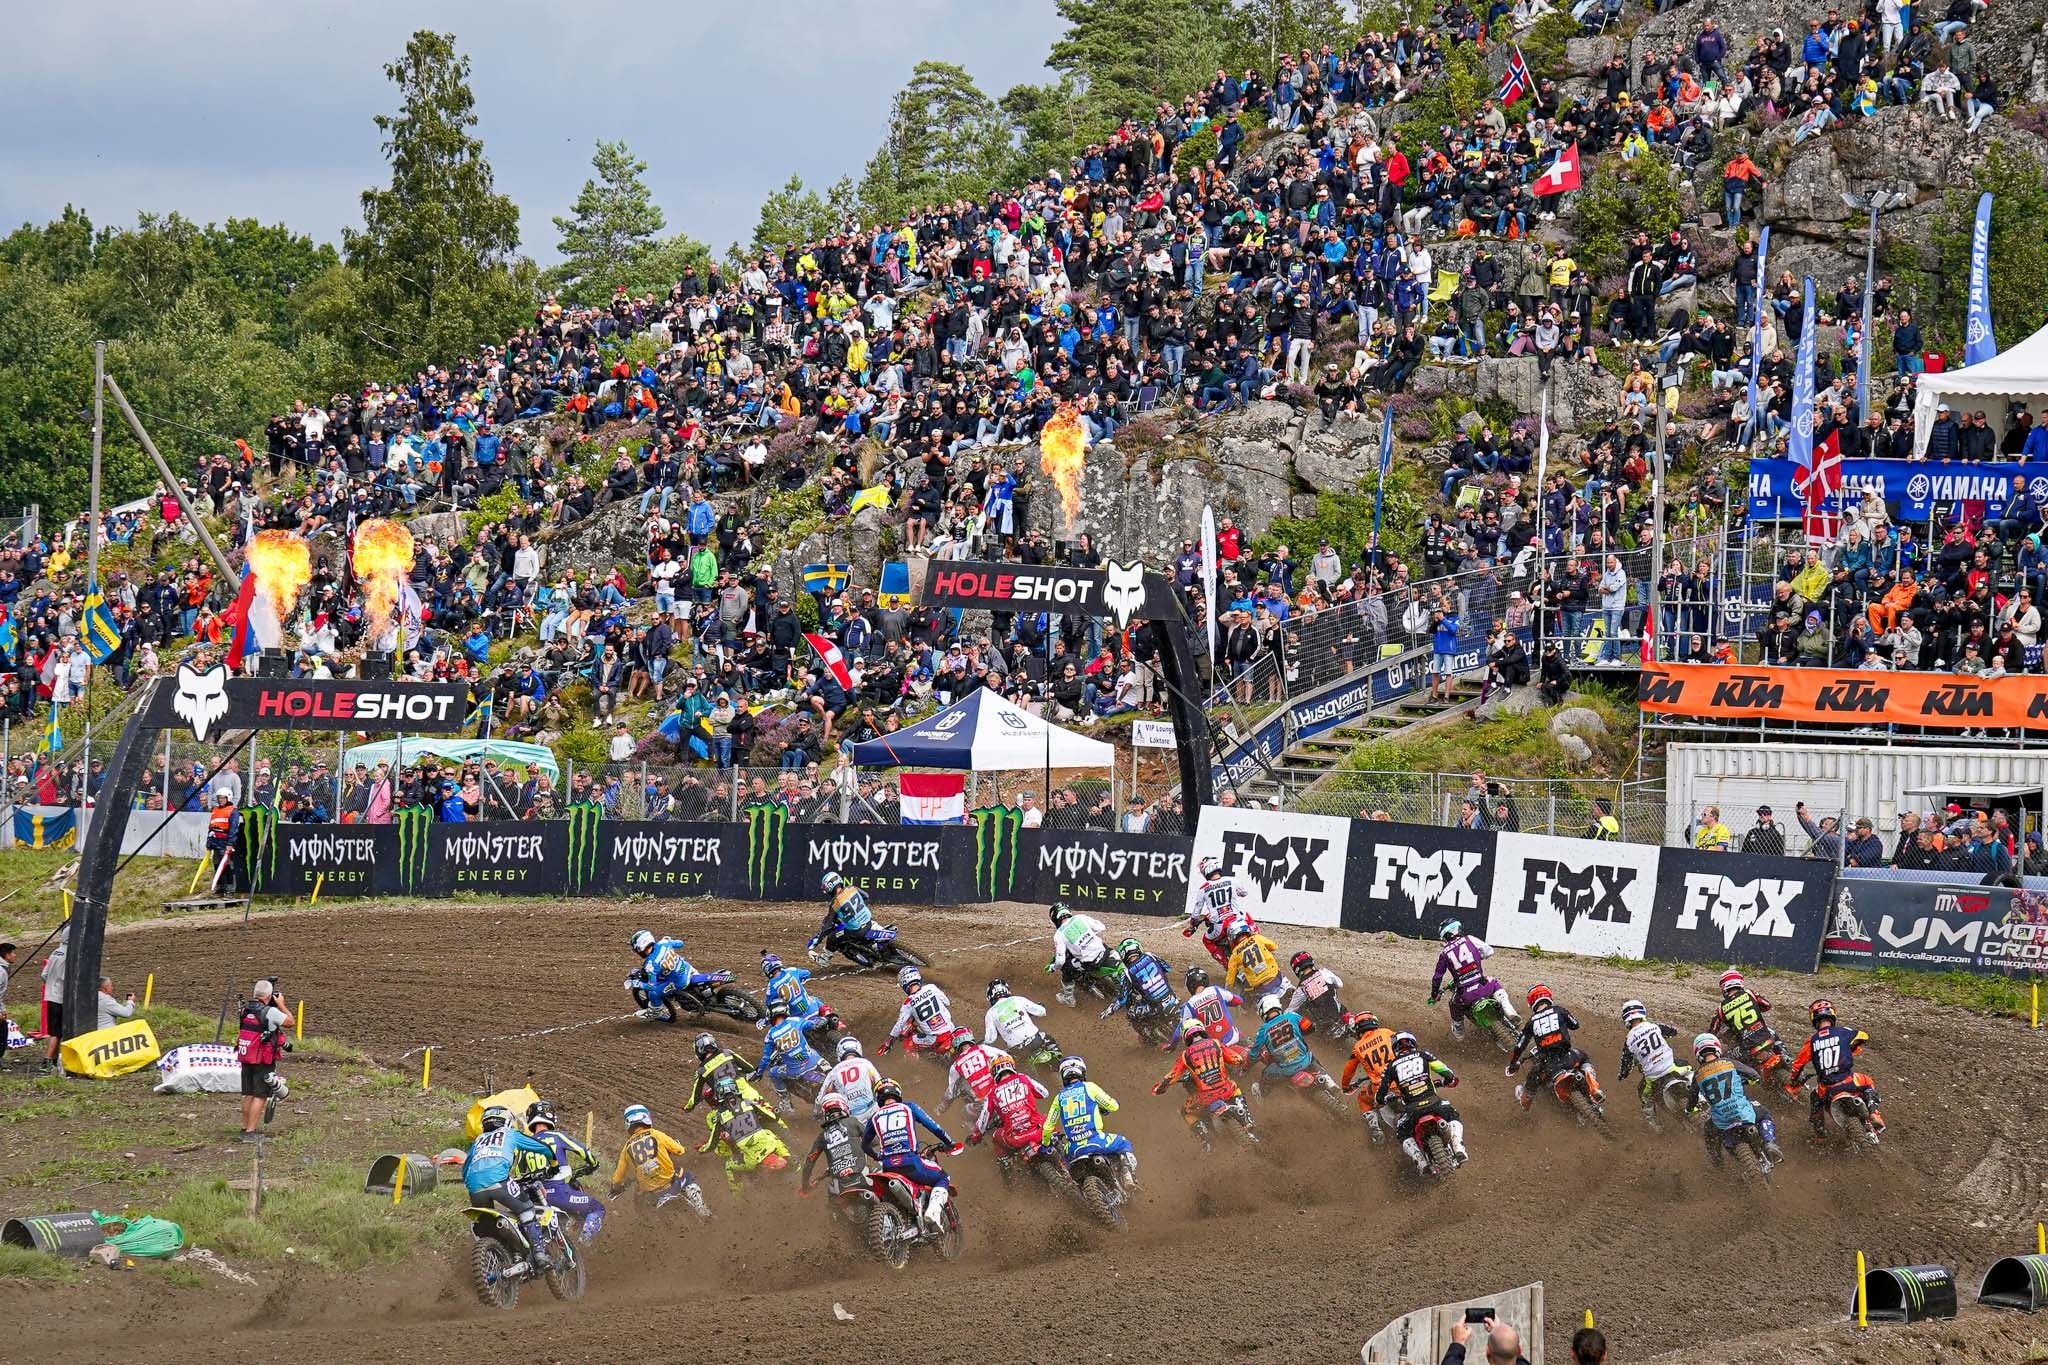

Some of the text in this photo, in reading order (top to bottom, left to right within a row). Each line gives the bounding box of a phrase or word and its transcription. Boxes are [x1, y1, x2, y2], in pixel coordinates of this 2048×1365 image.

[1970, 220, 1987, 314] YAMAHA
[1932, 475, 2008, 501] YAMAHA
[934, 571, 1093, 602] HOLESHOT
[1710, 674, 1784, 709] KTM
[1815, 679, 1890, 712] KTM
[1920, 684, 1993, 717] KTM
[259, 691, 454, 721] HOLESHOT
[305, 870, 366, 883] ENERGY
[458, 869, 529, 882] ENERGY
[626, 871, 703, 884] ENERGY
[842, 876, 919, 890] NERGY
[1060, 884, 1164, 902] ENERGY
[1208, 887, 1232, 908] 101
[1242, 943, 1262, 969] 41
[1447, 943, 1475, 970] 14
[1879, 950, 1971, 964] uddevallagp.com
[778, 977, 801, 1001] 91
[915, 996, 940, 1022] 61
[1198, 1000, 1223, 1028] 70
[1725, 1001, 1758, 1031] 75
[88, 1034, 150, 1066] THOR
[1363, 1044, 1391, 1071] 142
[1636, 1031, 1661, 1058] 30
[1818, 1049, 1841, 1070] 107
[840, 1066, 860, 1087] 10
[1702, 1072, 1732, 1105] 87
